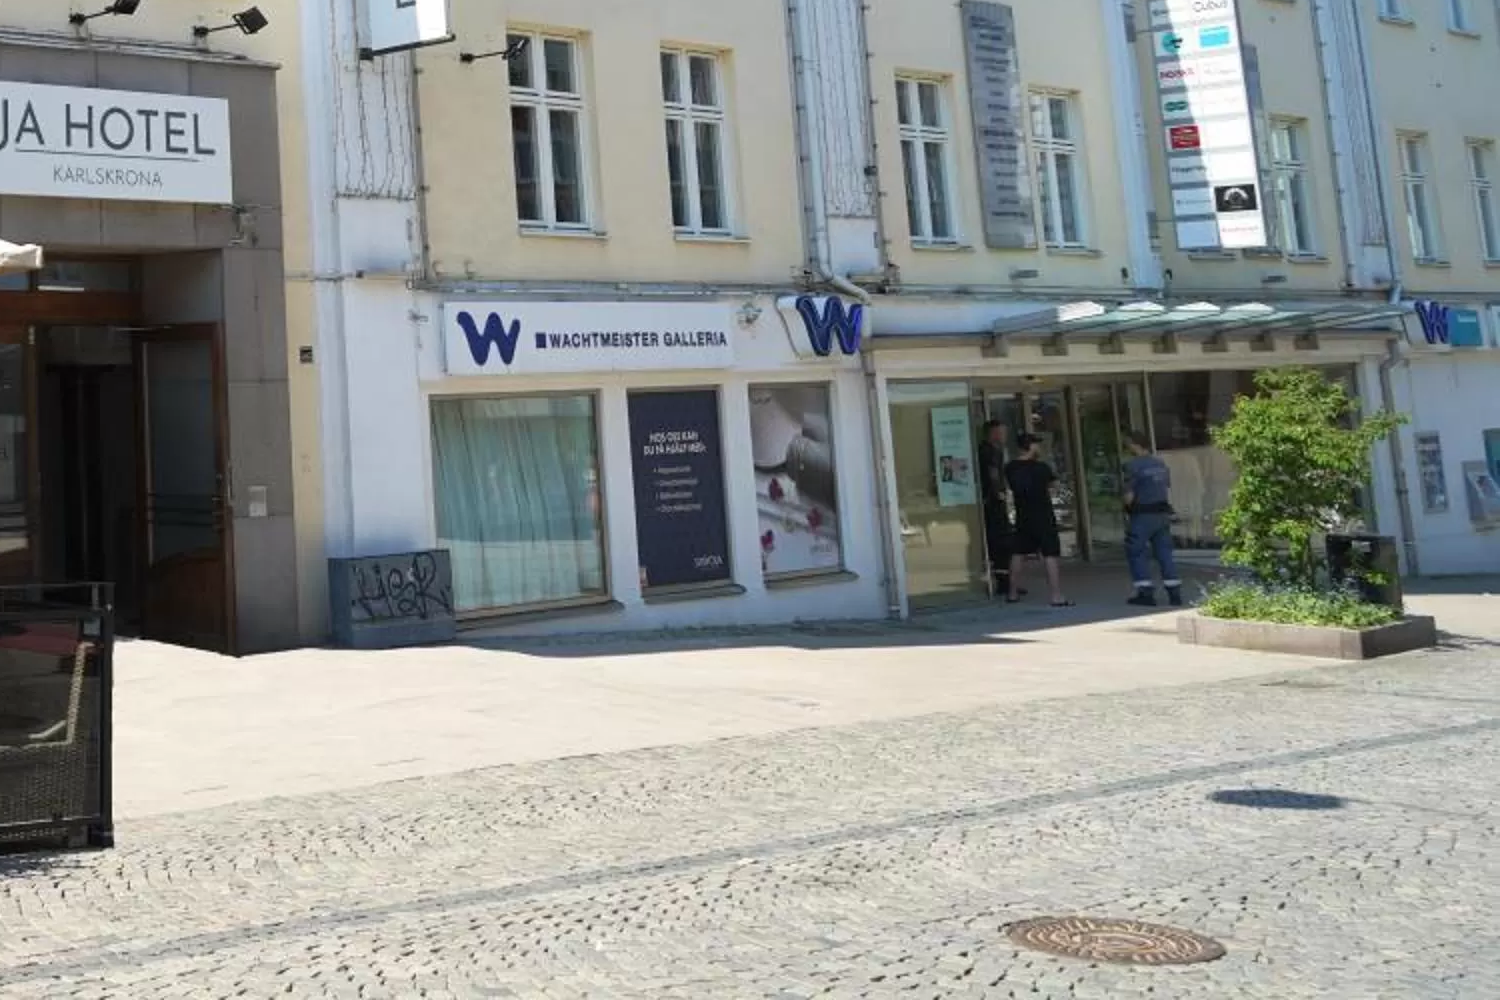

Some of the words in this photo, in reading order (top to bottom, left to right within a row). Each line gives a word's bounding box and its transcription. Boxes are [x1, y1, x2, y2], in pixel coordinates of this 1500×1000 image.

[65, 105, 216, 156] HOTEL
[53, 166, 163, 188] KARLSKRONA
[457, 311, 520, 366] W
[550, 331, 660, 349] WACHTMEISTER
[663, 330, 728, 348] GALLERIA
[795, 295, 862, 357] W
